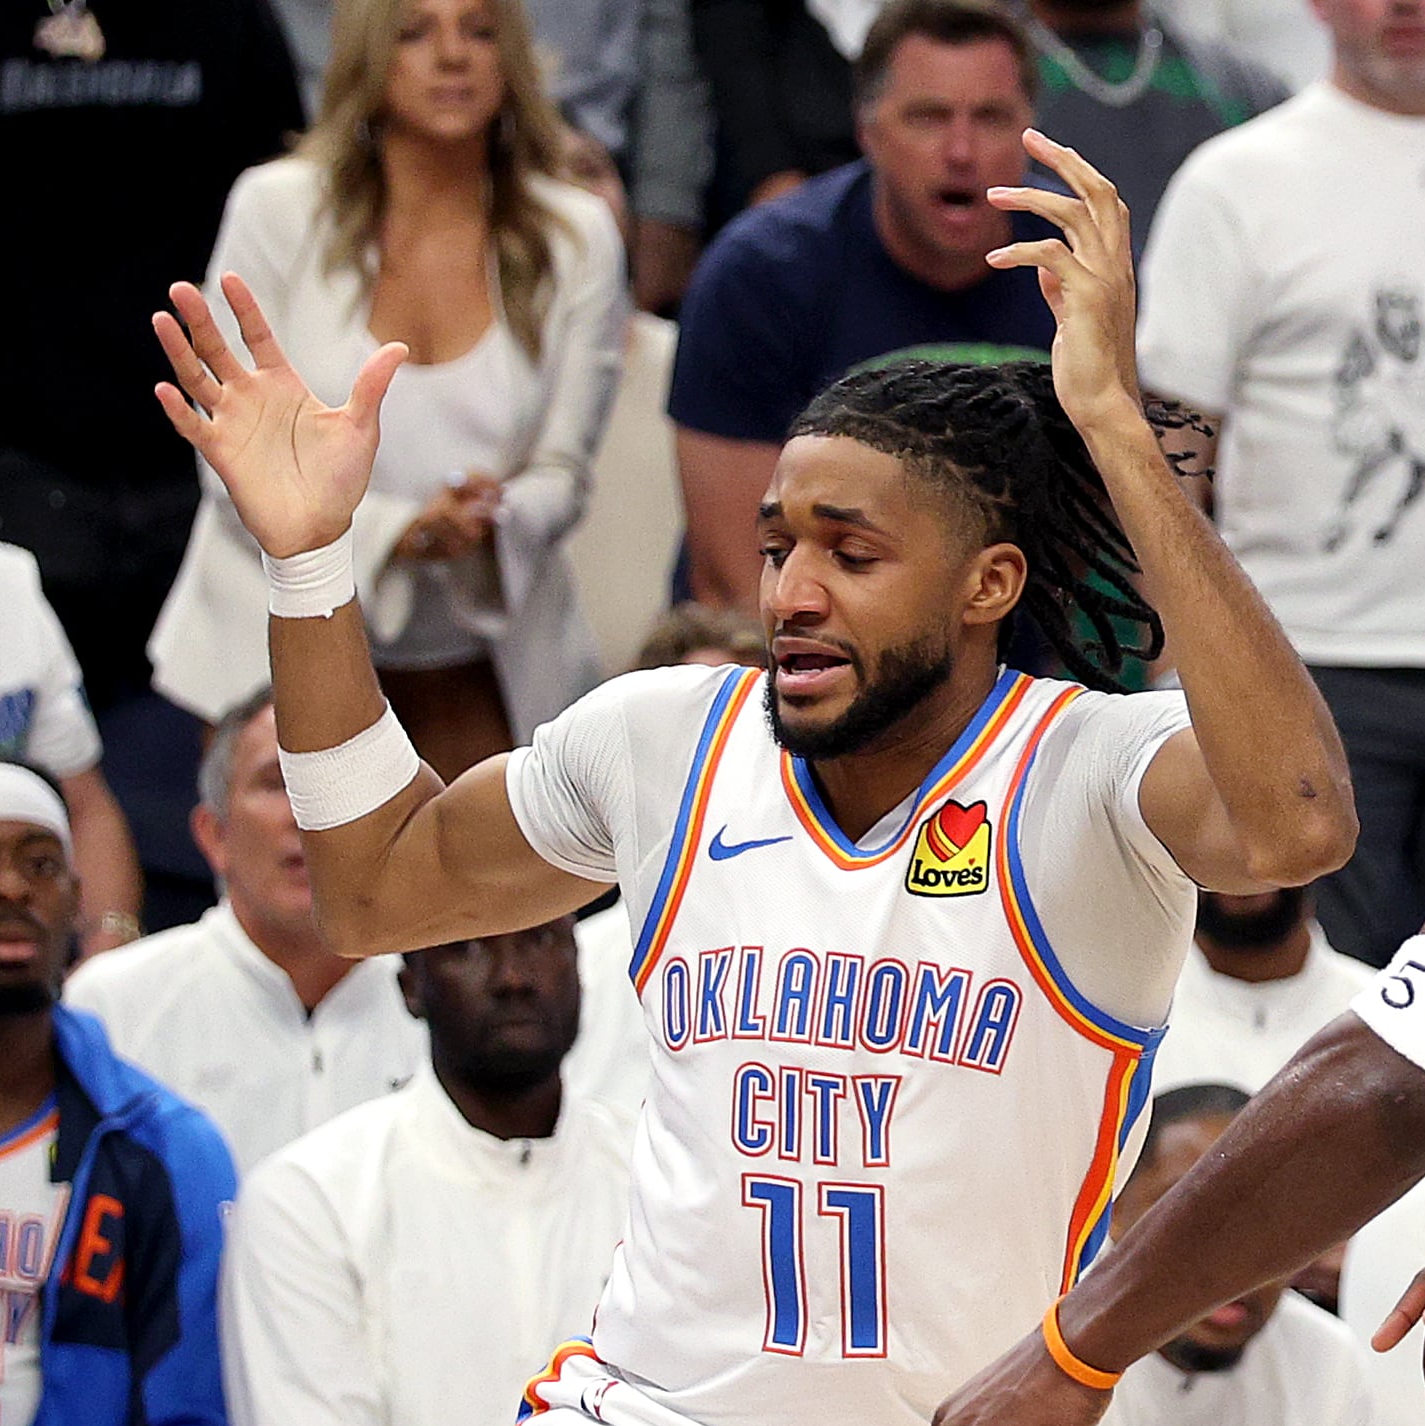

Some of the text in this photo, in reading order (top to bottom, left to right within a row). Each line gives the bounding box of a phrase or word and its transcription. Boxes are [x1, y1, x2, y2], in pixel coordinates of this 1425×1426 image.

[662, 946, 1023, 1075] OKLAHOMA
[731, 1061, 902, 1167] CITY
[741, 1173, 888, 1358] 11
